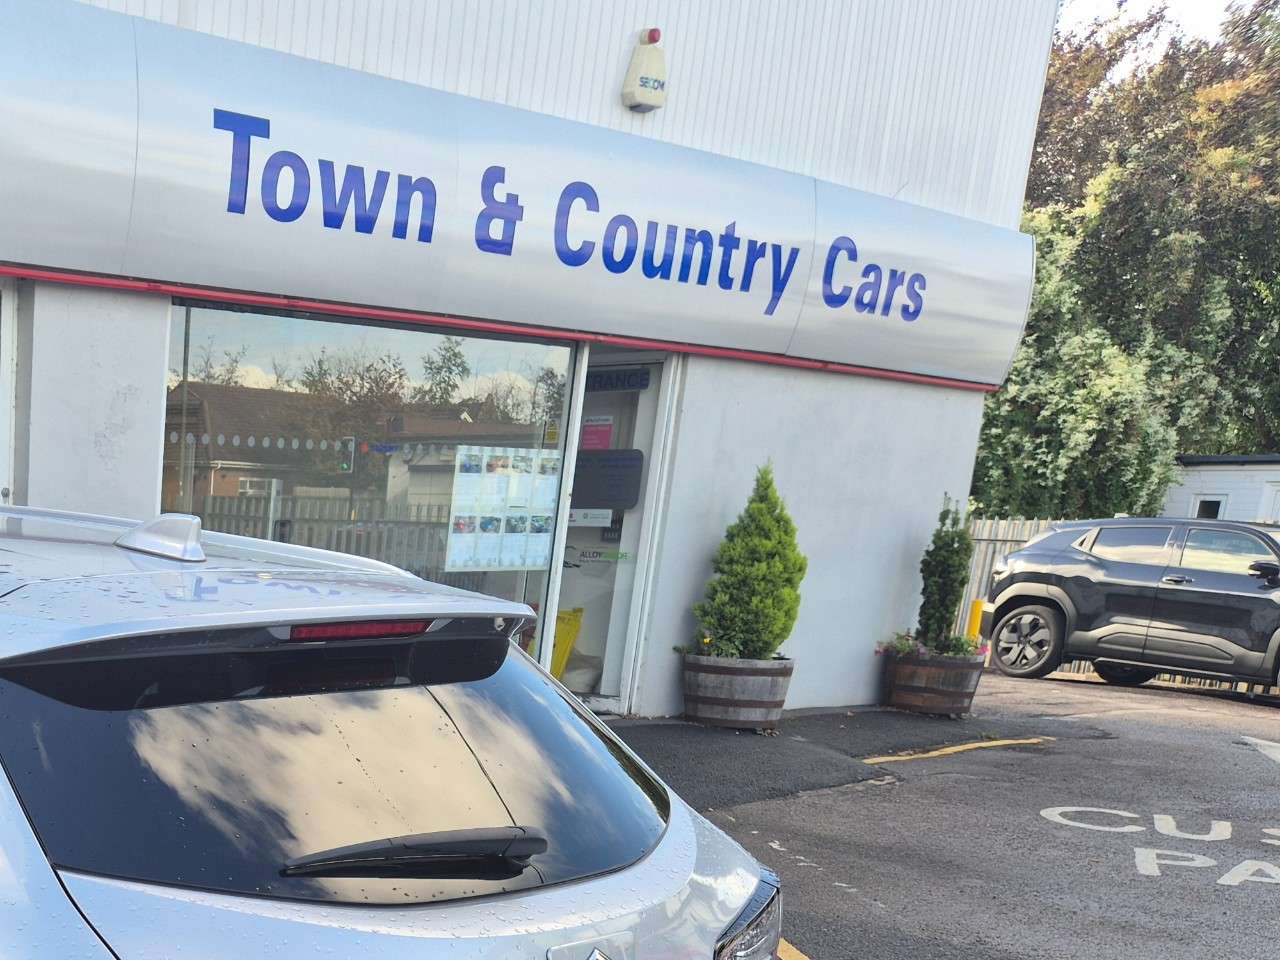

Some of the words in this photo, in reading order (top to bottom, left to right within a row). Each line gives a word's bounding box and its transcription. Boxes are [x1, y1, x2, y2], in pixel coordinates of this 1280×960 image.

[214, 108, 437, 243] Town
[475, 165, 524, 256] &
[554, 181, 799, 316] Country
[823, 236, 926, 322] Cars
